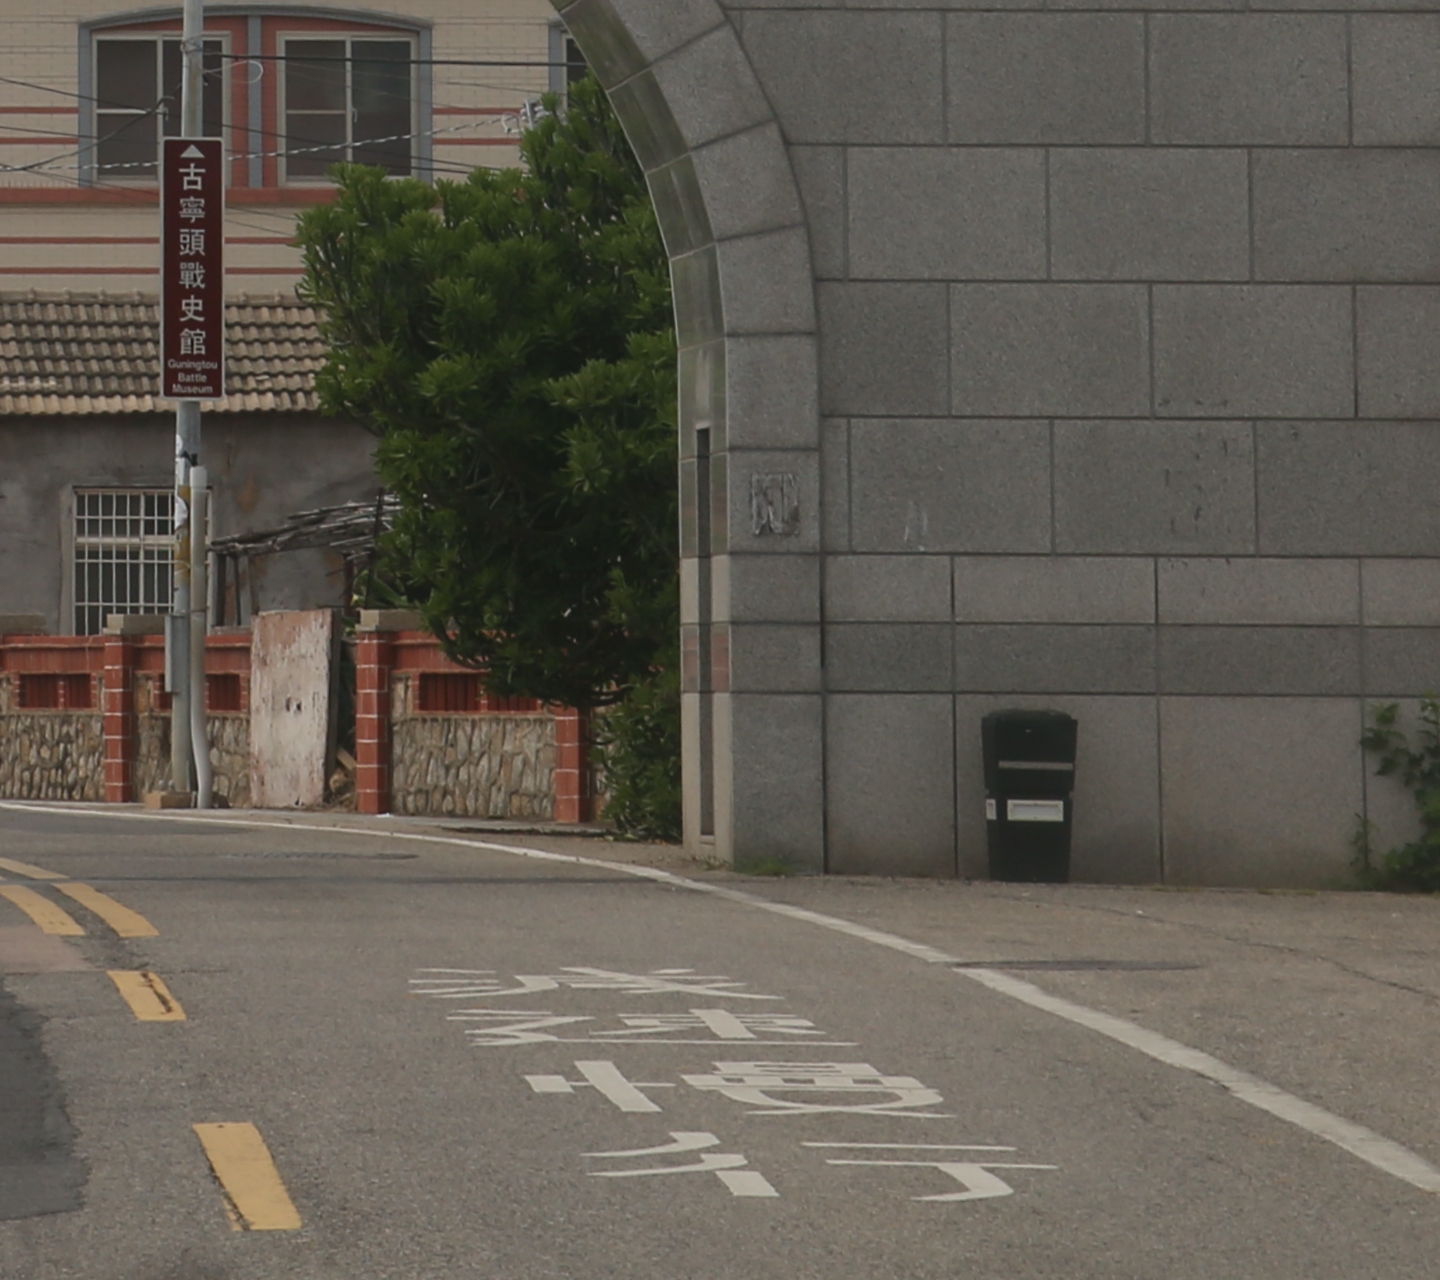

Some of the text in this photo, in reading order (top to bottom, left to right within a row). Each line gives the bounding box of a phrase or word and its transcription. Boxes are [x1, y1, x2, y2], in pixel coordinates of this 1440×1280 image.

[178, 162, 206, 356] 古寧頭戰史館
[167, 358, 218, 372] Guningtou
[177, 372, 208, 383] Battle
[171, 383, 213, 394] Museum
[408, 966, 1059, 1203] 減速慢行
